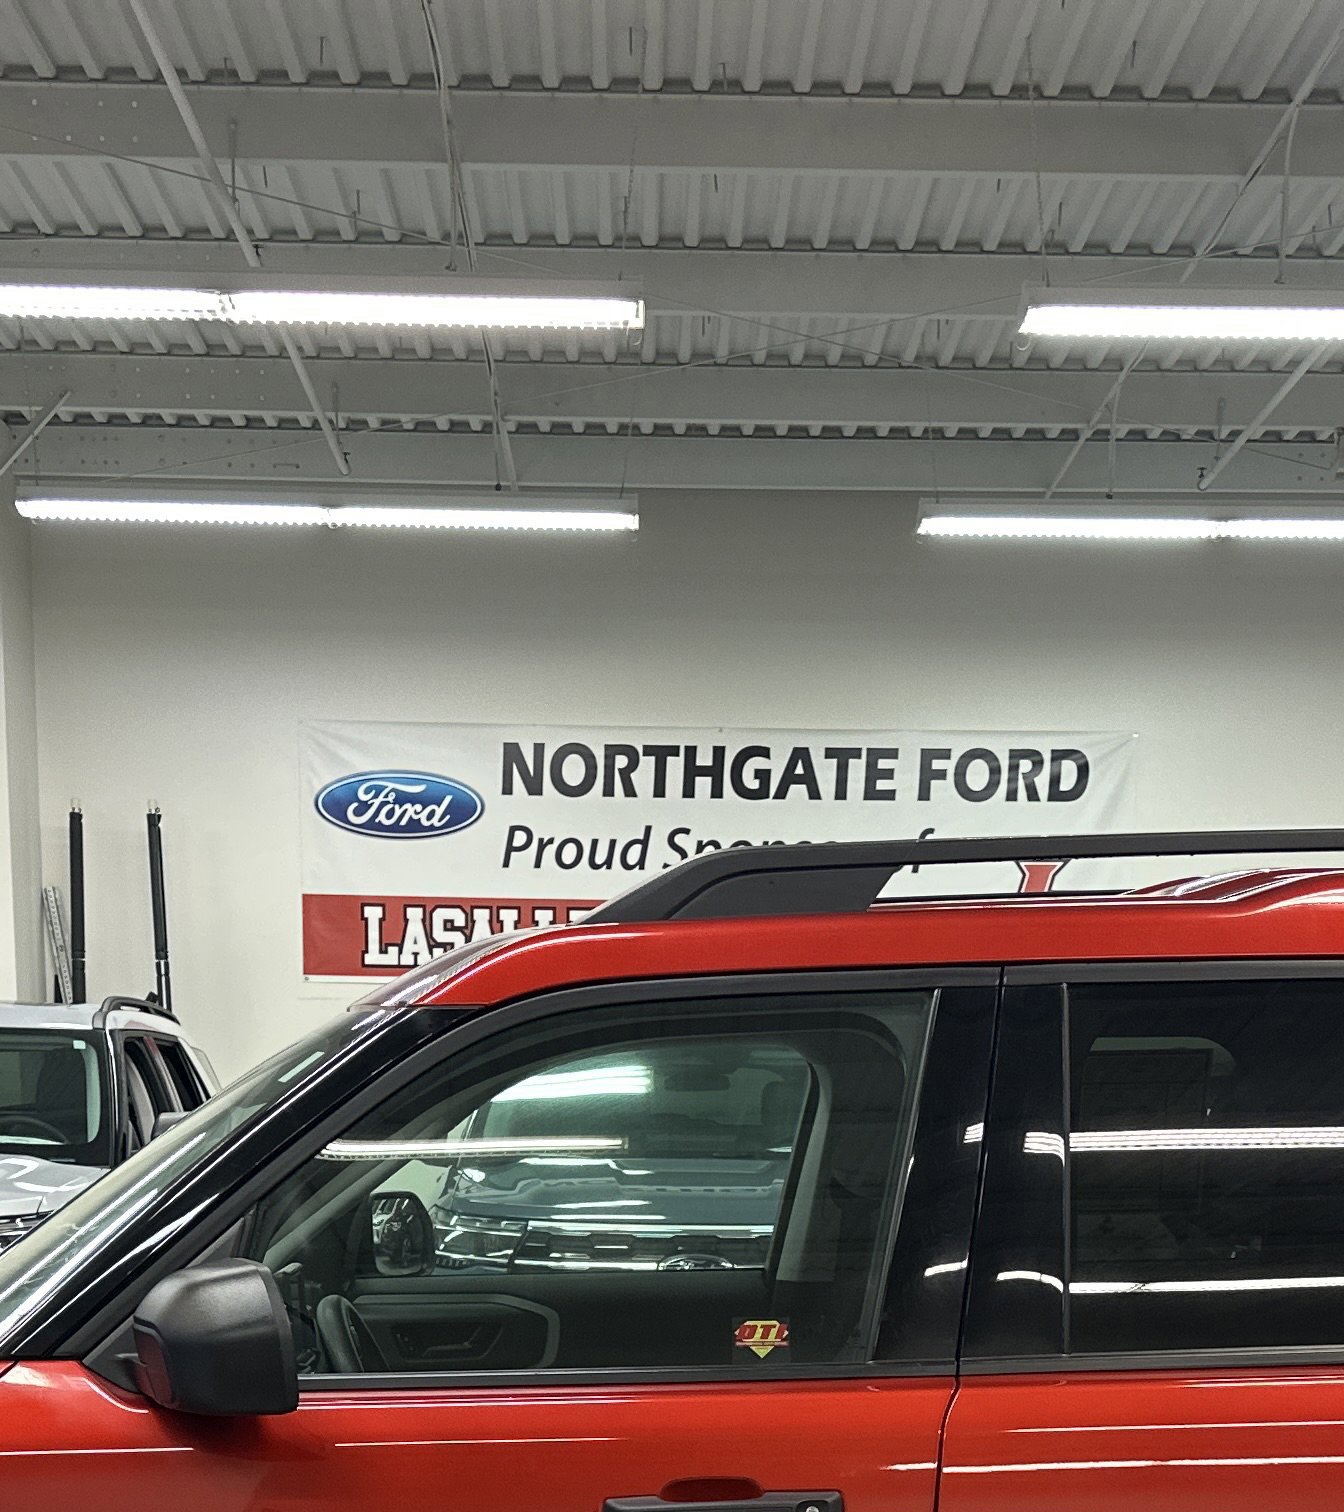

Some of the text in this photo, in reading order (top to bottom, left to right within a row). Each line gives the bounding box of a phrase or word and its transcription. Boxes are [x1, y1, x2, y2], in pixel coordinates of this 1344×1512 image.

[501, 742, 1090, 802] NORTHGATE FORD
[346, 780, 453, 827] Ford
[501, 824, 652, 871] Proud
[361, 902, 596, 968] LASA
